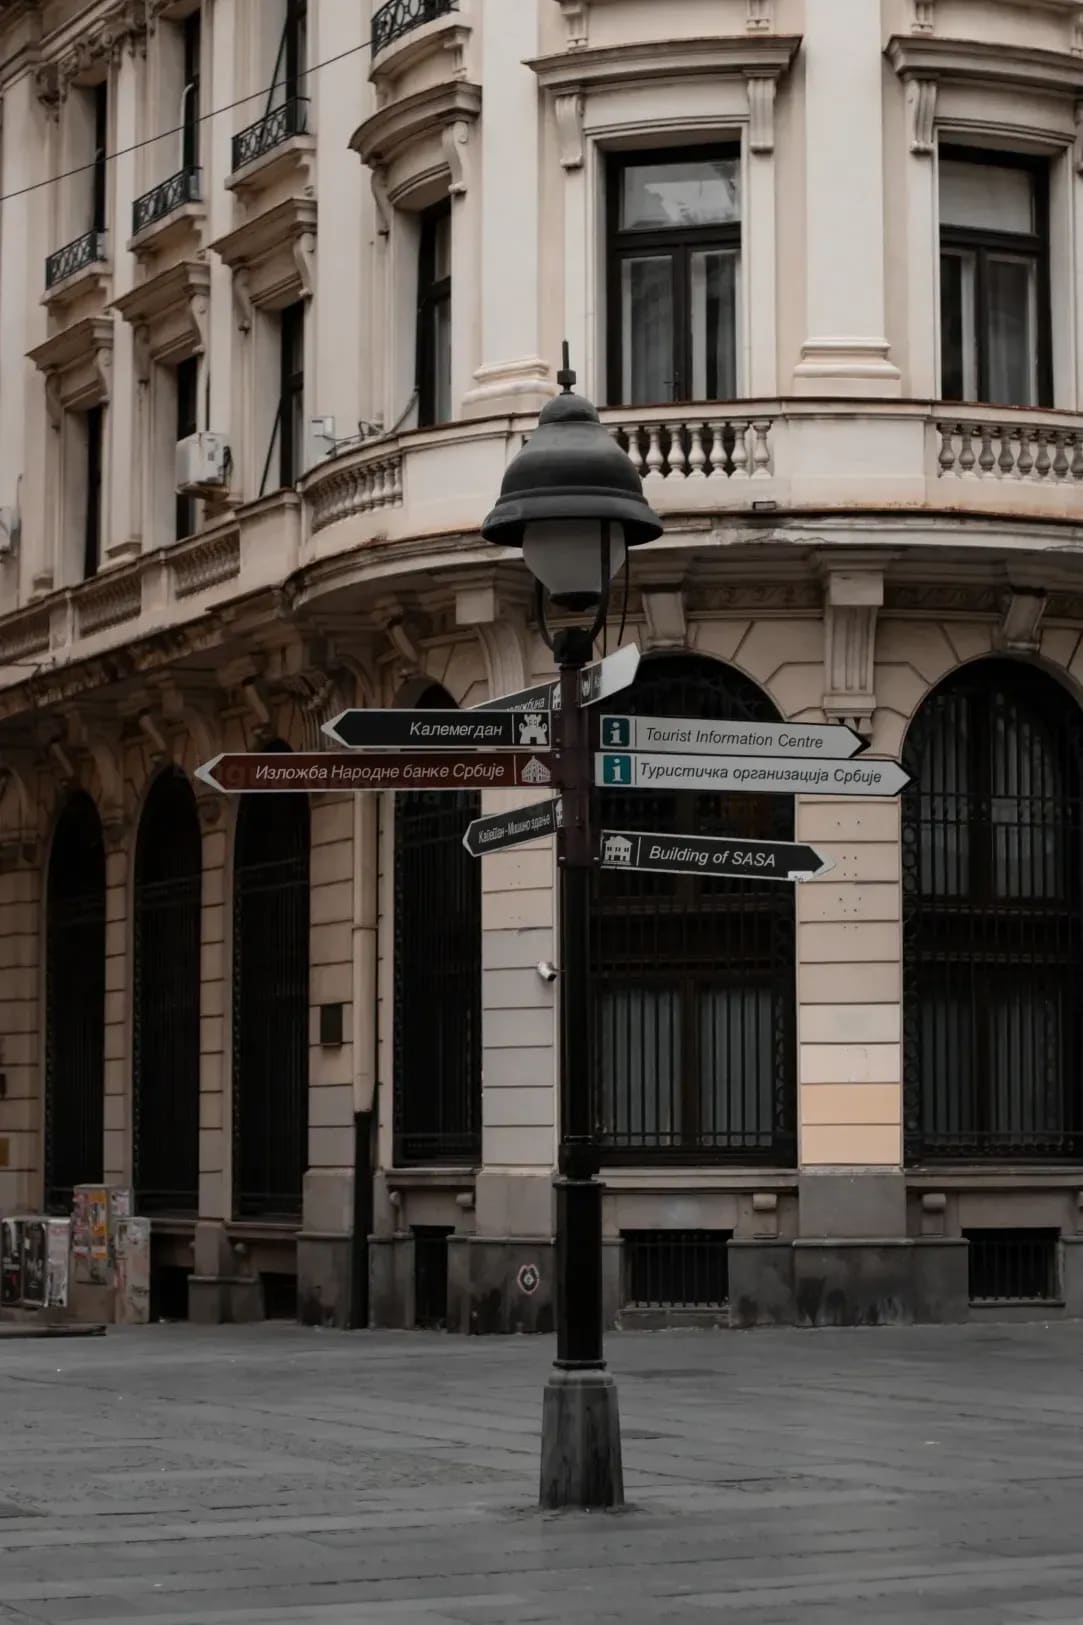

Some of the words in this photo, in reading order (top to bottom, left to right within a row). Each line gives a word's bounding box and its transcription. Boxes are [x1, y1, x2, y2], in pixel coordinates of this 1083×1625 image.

[410, 721, 503, 739] Калемегдан
[646, 727, 692, 743] Tourist
[695, 729, 773, 747] Information
[778, 733, 824, 749] Centre
[256, 764, 328, 780] Изложба
[331, 764, 400, 781] Народне
[403, 763, 449, 778] банке
[453, 763, 505, 780] Србије
[641, 762, 729, 780] Туристичка
[733, 768, 829, 785] организација
[833, 768, 882, 786] Србије
[649, 845, 710, 866] Building
[712, 850, 730, 864] of
[731, 851, 776, 868] SASA
